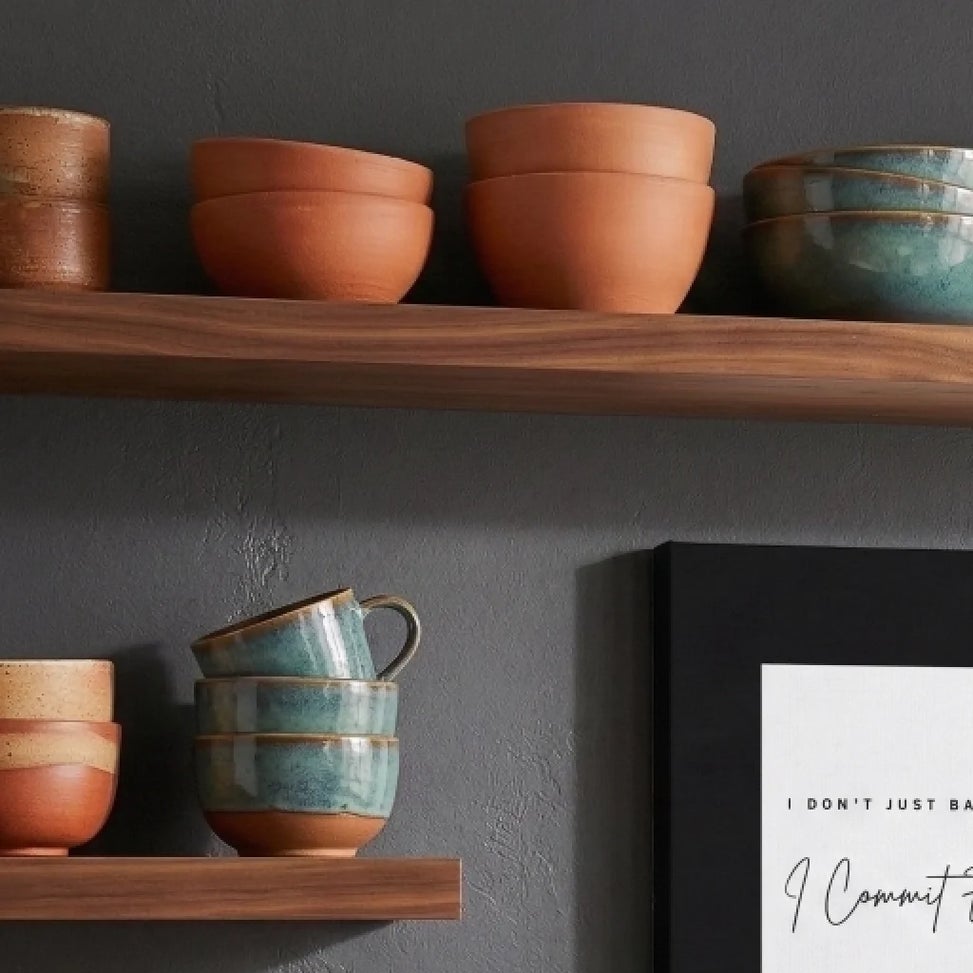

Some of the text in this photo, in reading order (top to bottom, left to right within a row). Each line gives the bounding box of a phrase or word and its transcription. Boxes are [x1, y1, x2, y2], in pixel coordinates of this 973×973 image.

[787, 796, 793, 811] I
[807, 796, 873, 811] DON'T
[884, 797, 937, 811] JUST
[784, 856, 811, 934] I
